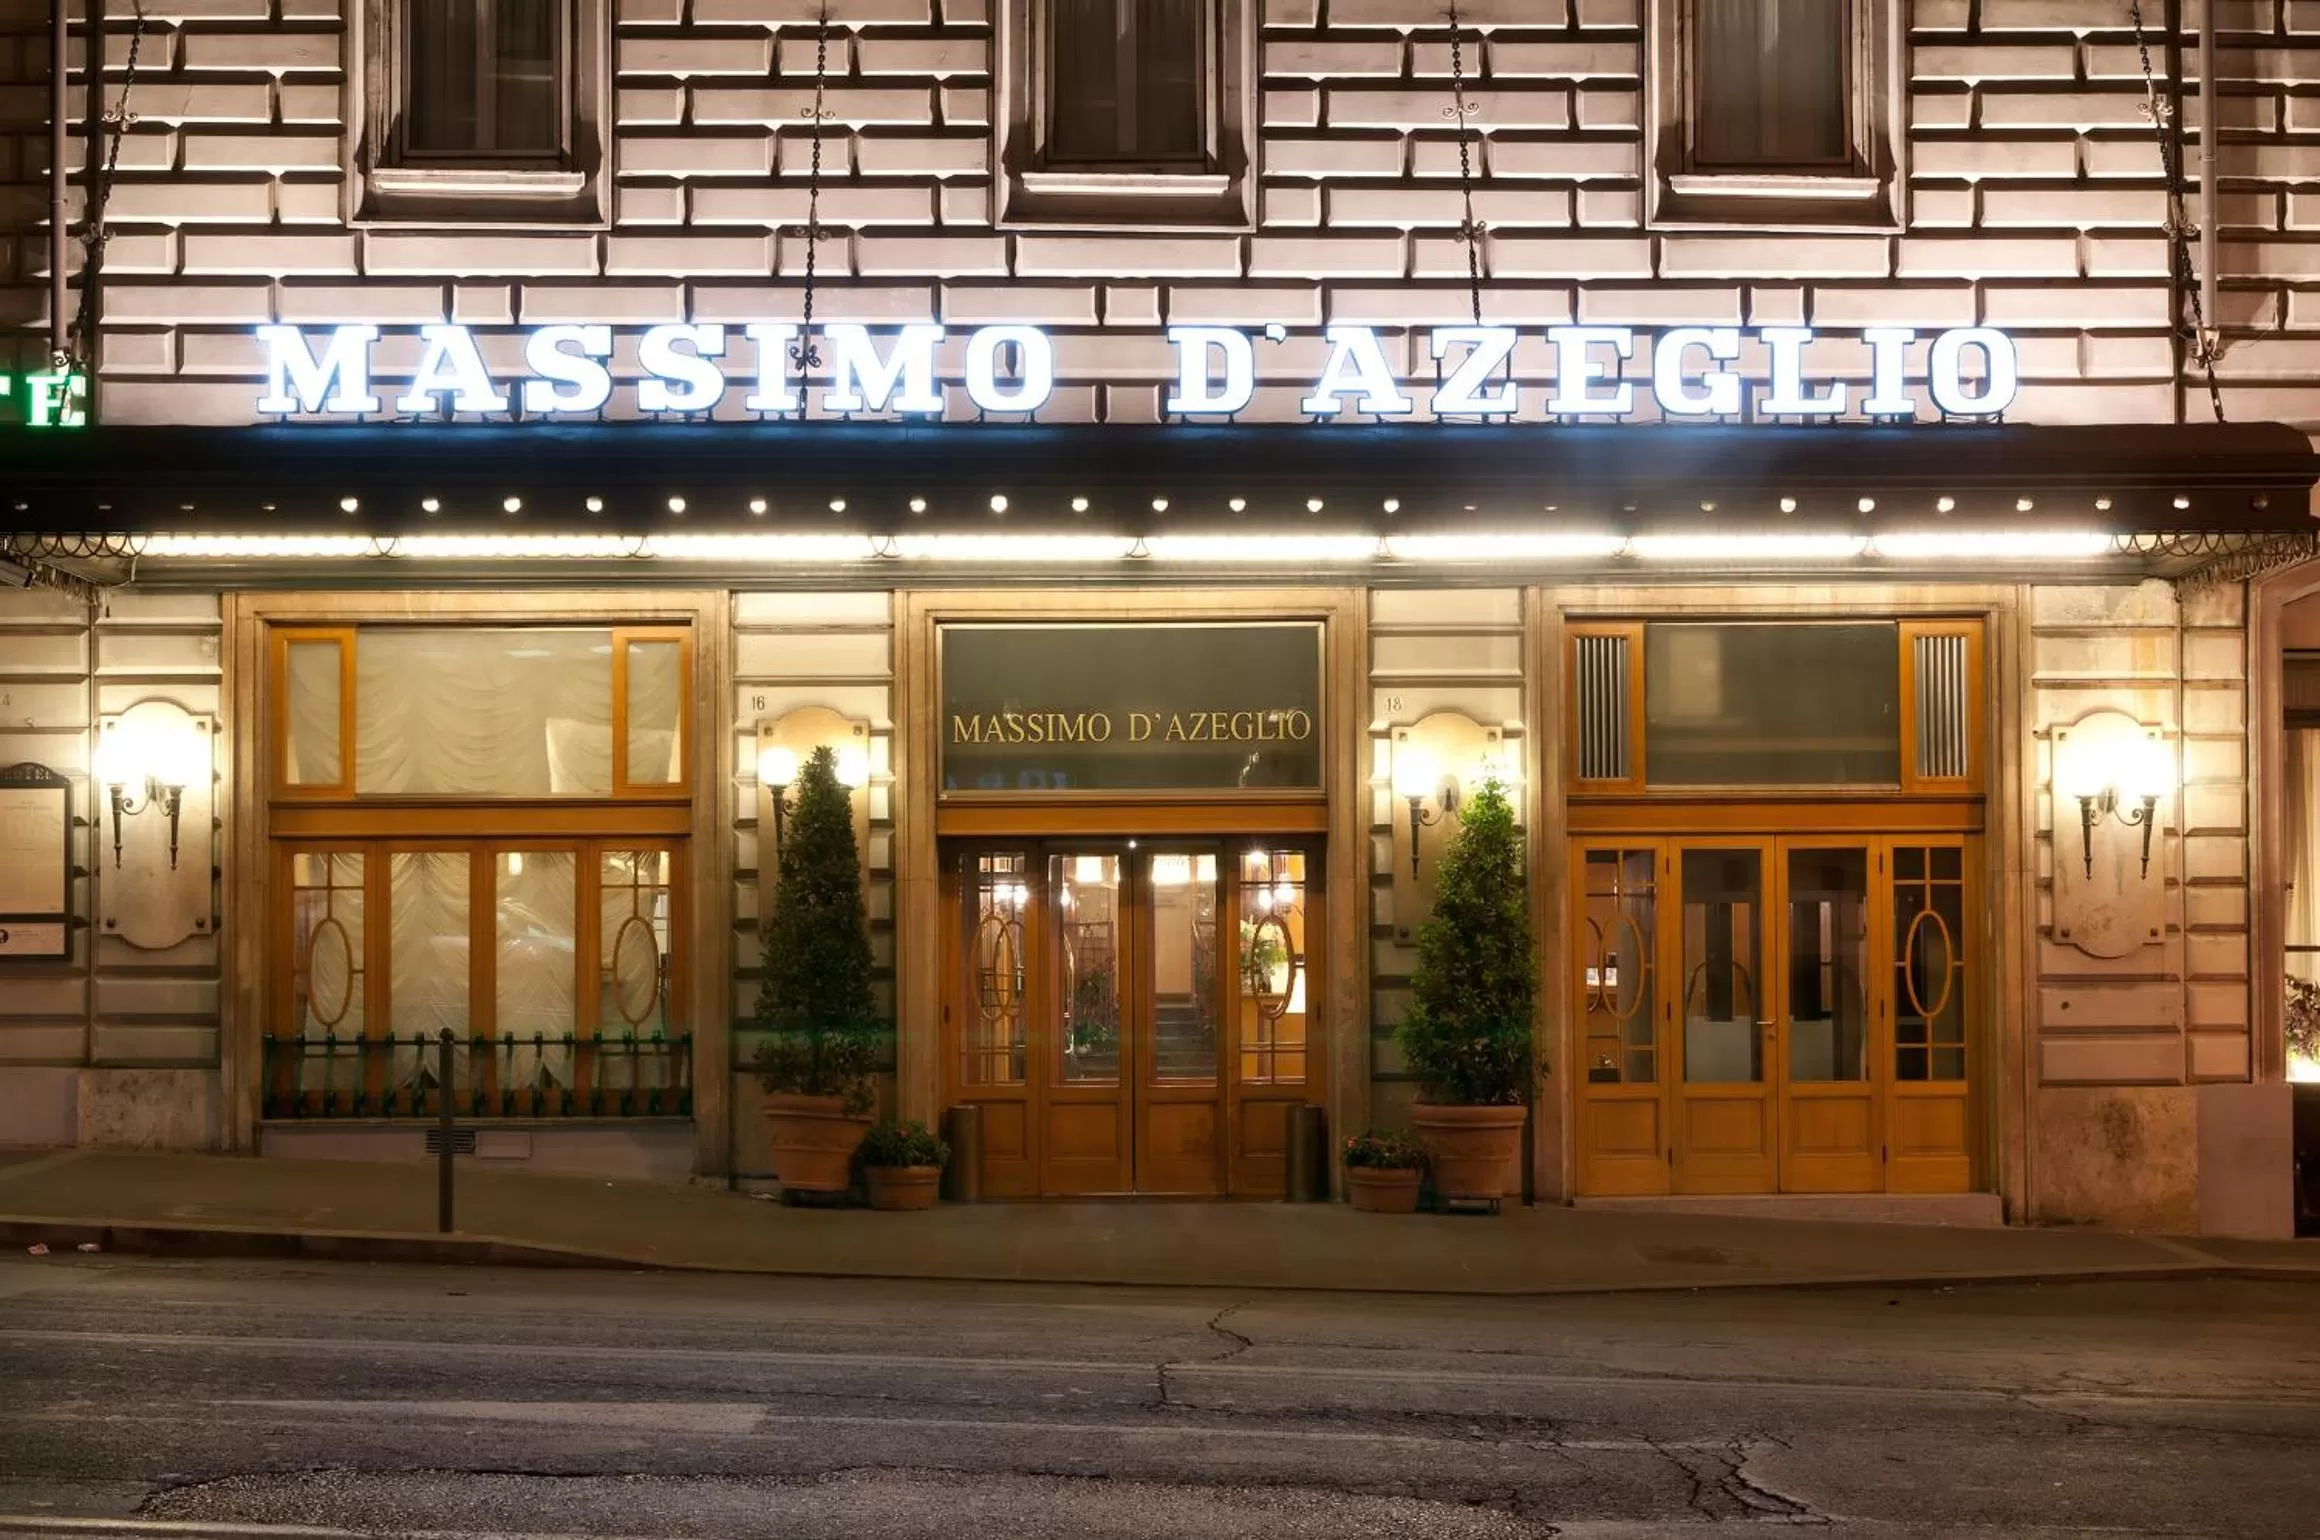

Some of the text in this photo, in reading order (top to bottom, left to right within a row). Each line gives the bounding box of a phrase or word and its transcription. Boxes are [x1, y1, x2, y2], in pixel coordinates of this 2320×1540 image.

[257, 323, 2018, 414] MASSIMO D'AZEGLIO
[752, 695, 766, 712] 16
[1387, 696, 1402, 712] 18
[952, 709, 1312, 743] MASSIMO D'AZEGLIO
